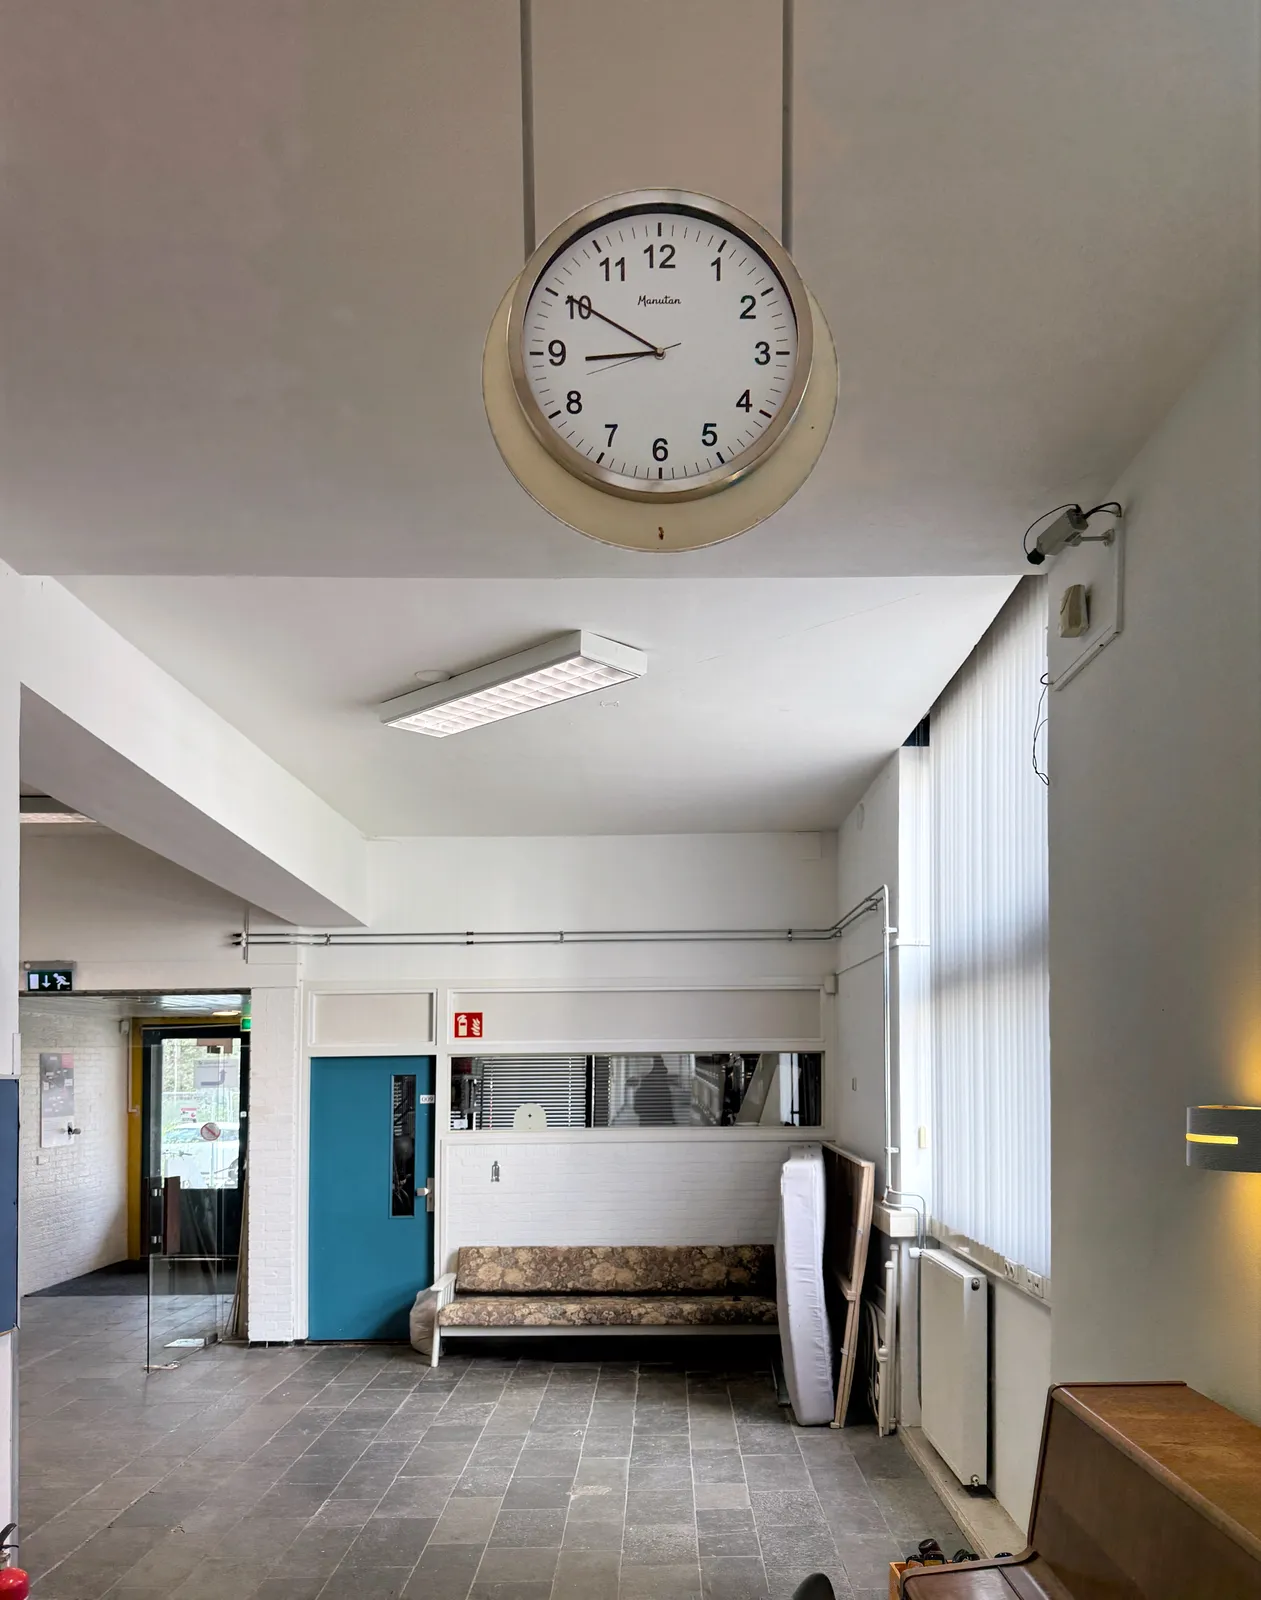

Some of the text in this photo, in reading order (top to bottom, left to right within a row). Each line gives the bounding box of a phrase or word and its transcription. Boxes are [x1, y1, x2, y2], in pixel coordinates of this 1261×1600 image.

[599, 257, 625, 281] 11
[643, 244, 676, 269] 12
[710, 257, 721, 281] 1
[565, 295, 592, 320] 10
[637, 294, 682, 308] Manutan
[740, 295, 757, 320] 2
[547, 339, 567, 367] 9
[754, 341, 771, 366] 3
[566, 390, 583, 415] 8
[735, 389, 753, 413] 4
[604, 424, 619, 448] 7
[701, 423, 718, 447] 5
[652, 437, 669, 462] 6
